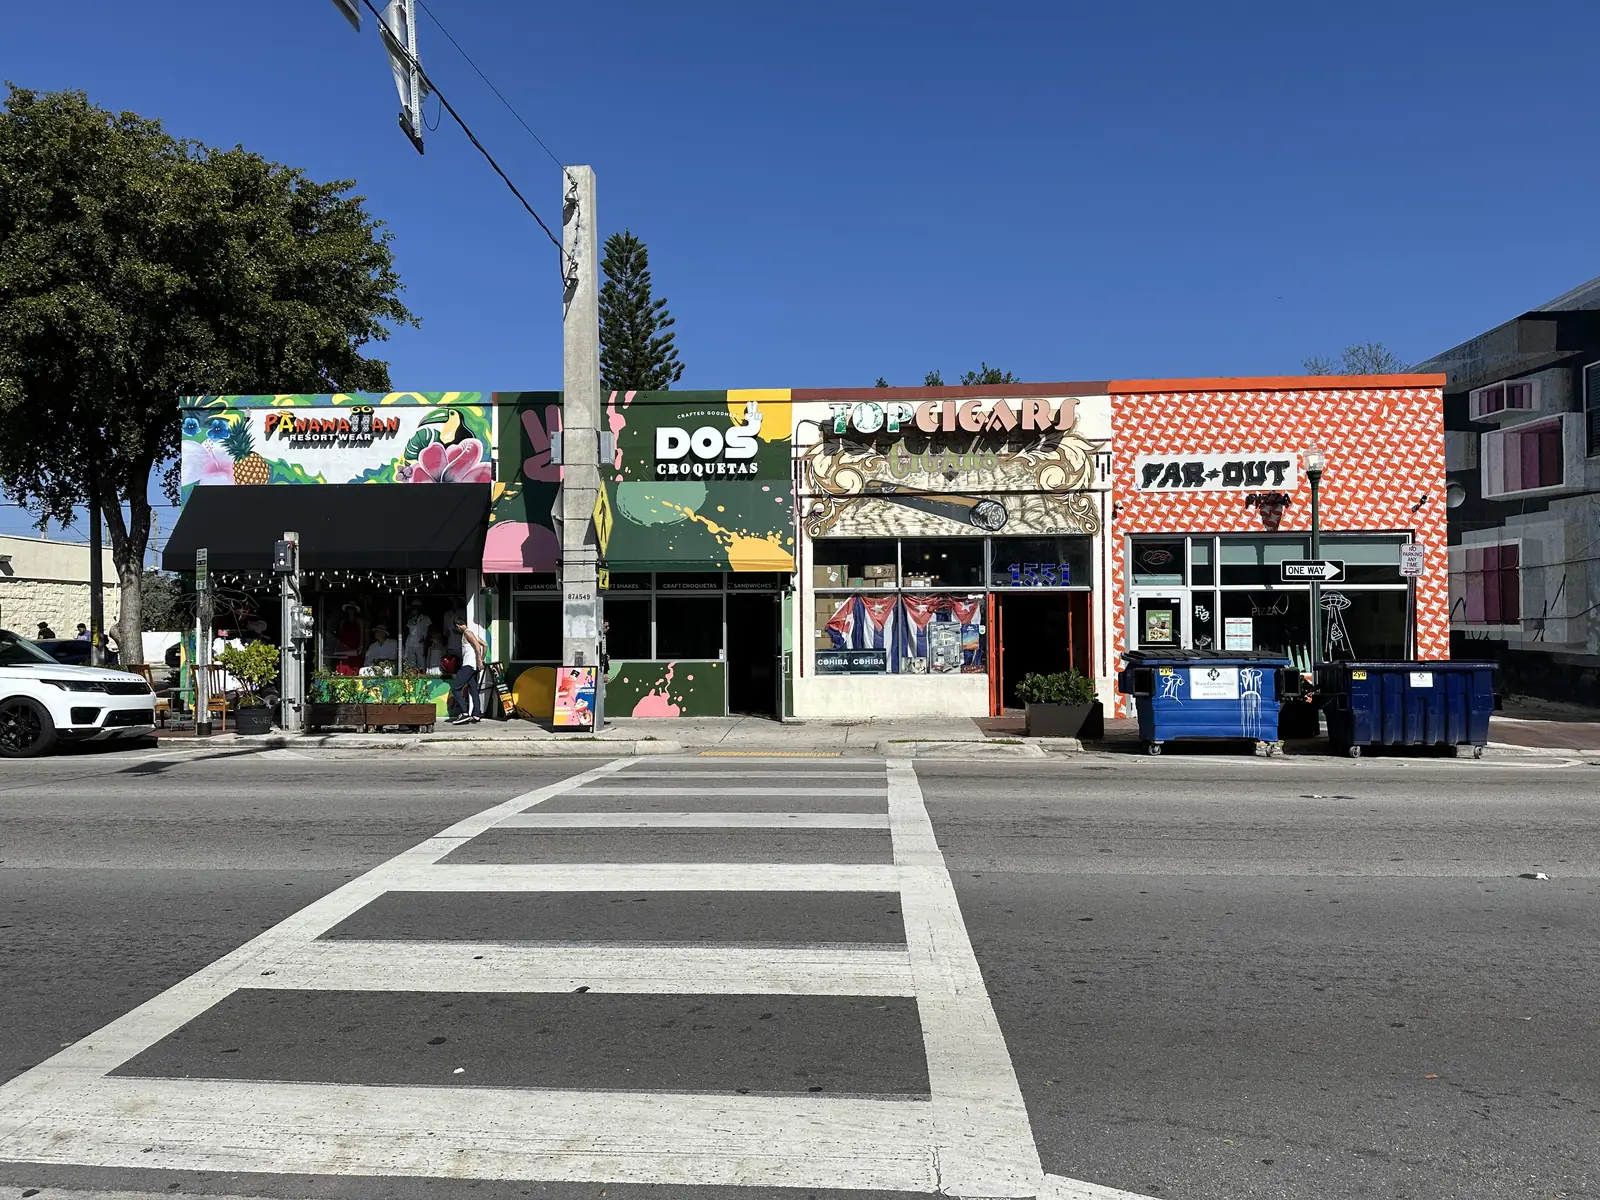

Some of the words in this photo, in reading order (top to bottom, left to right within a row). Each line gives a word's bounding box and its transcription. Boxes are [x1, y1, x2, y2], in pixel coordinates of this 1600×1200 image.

[677, 411, 705, 419] CRAFTED
[707, 411, 741, 419] GOODNE
[828, 401, 915, 434] TOP
[915, 398, 1080, 432] CIGARS
[289, 433, 336, 441] RESORT
[339, 433, 372, 441] WEAR
[656, 410, 761, 459] DOS
[657, 463, 758, 477] CROQUETAS
[1141, 461, 1206, 488] FAR
[1222, 460, 1290, 487] OUT
[1007, 562, 1071, 586] 1551
[1287, 566, 1305, 574] ONE
[1307, 566, 1325, 574] WAY
[1251, 607, 1278, 617] PIZZA
[817, 658, 849, 666] COHIBA
